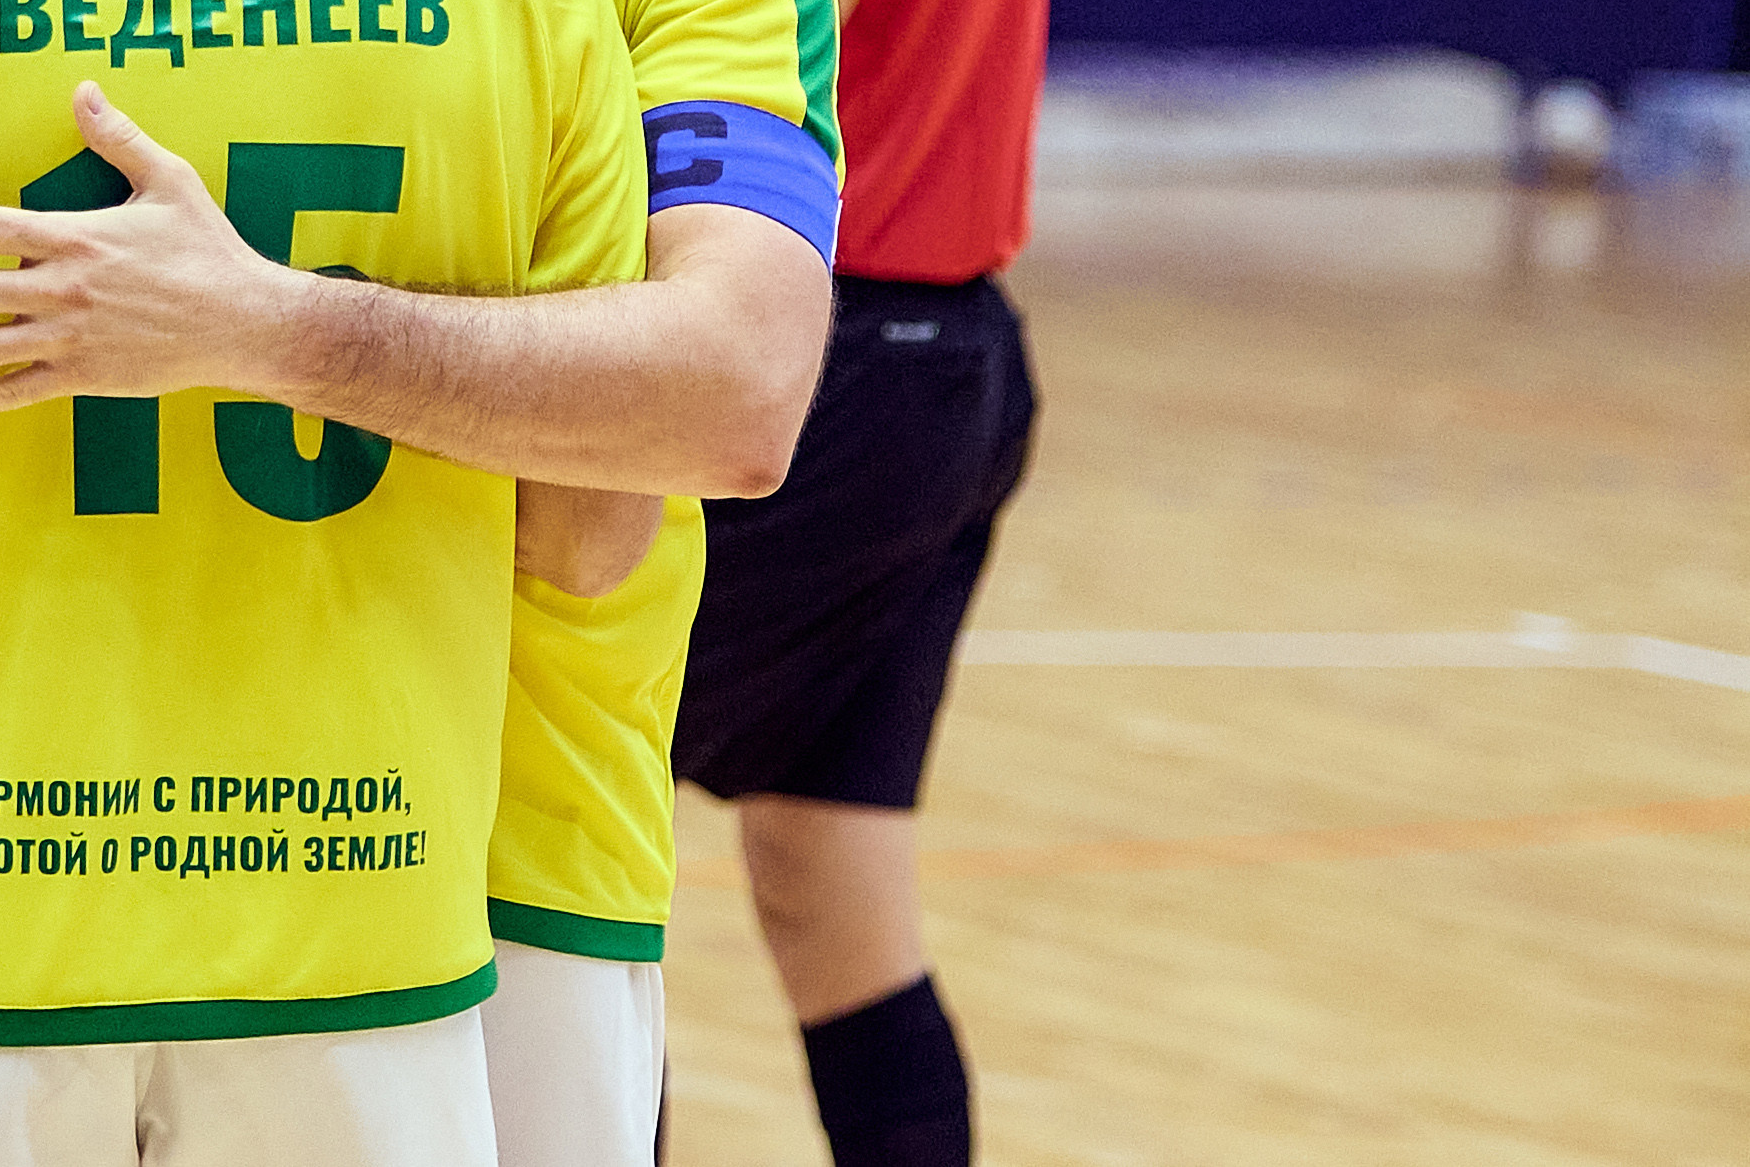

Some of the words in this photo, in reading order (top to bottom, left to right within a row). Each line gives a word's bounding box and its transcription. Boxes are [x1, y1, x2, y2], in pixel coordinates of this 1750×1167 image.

[153, 775, 176, 813] С
[190, 768, 412, 822] ПРИРОДОЙ,
[100, 839, 119, 875] О
[129, 829, 290, 879] РОДНОЙ
[303, 830, 427, 873] ЗЕМЛЕ!
